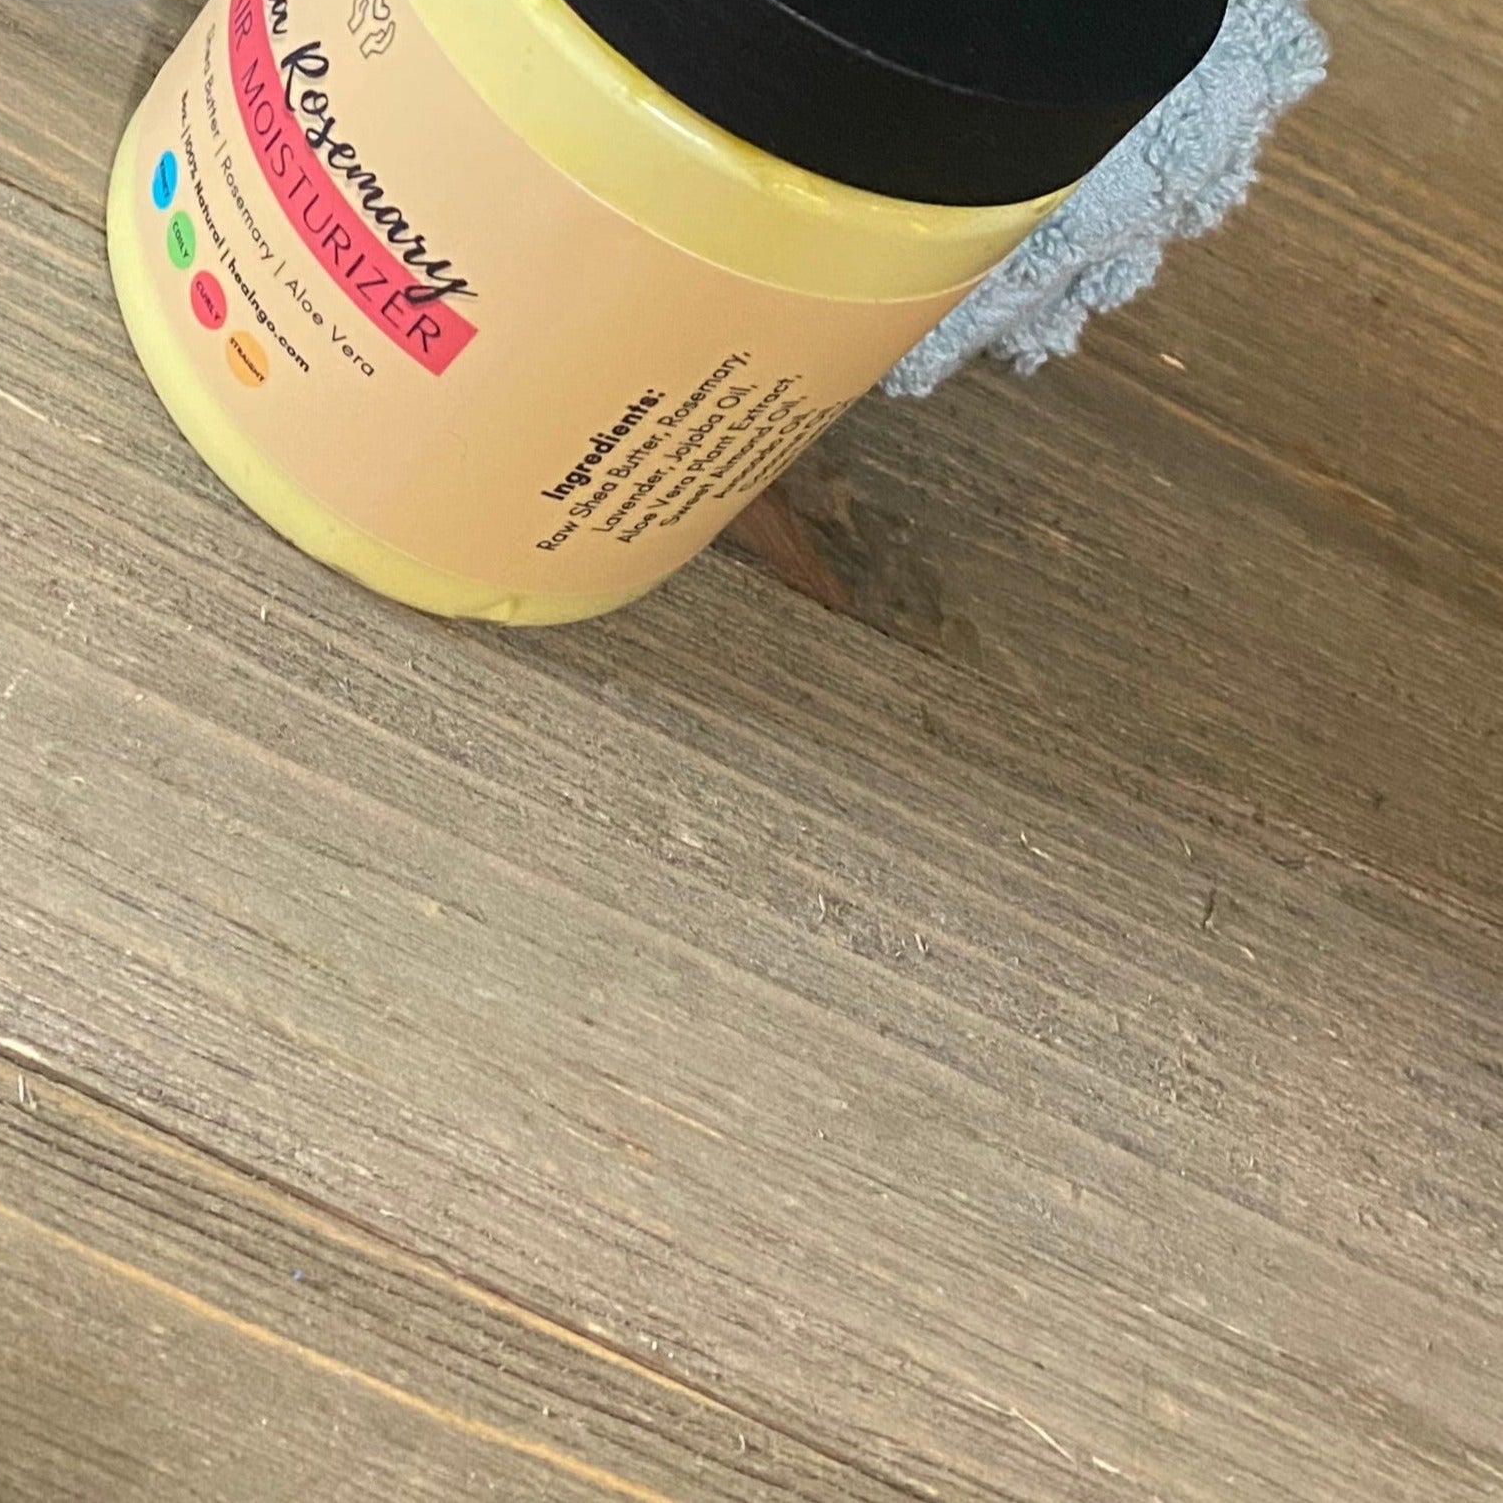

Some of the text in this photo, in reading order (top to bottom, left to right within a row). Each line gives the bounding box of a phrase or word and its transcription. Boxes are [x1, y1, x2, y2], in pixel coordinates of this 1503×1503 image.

[172, 220, 190, 260] COILY
[220, 154, 275, 261] Rosemary
[285, 278, 324, 326] Aloe
[331, 324, 376, 377] Vera
[241, 57, 442, 355] MOISTURIZER
[281, 40, 479, 308] Rosemary
[194, 178, 227, 250] Natural
[227, 257, 310, 374] healngo.com
[195, 280, 222, 322] CURLY
[535, 349, 752, 552] Raw Shea Butter, Rosemary,
[540, 388, 666, 501] Ingredients:
[591, 465, 676, 533] Lavender,
[663, 413, 724, 463] Jojoba
[716, 384, 758, 410] Oil,
[616, 512, 658, 545] Aloe
[647, 474, 698, 510] Vera
[687, 434, 736, 474] Plant
[726, 374, 803, 432] Extract,
